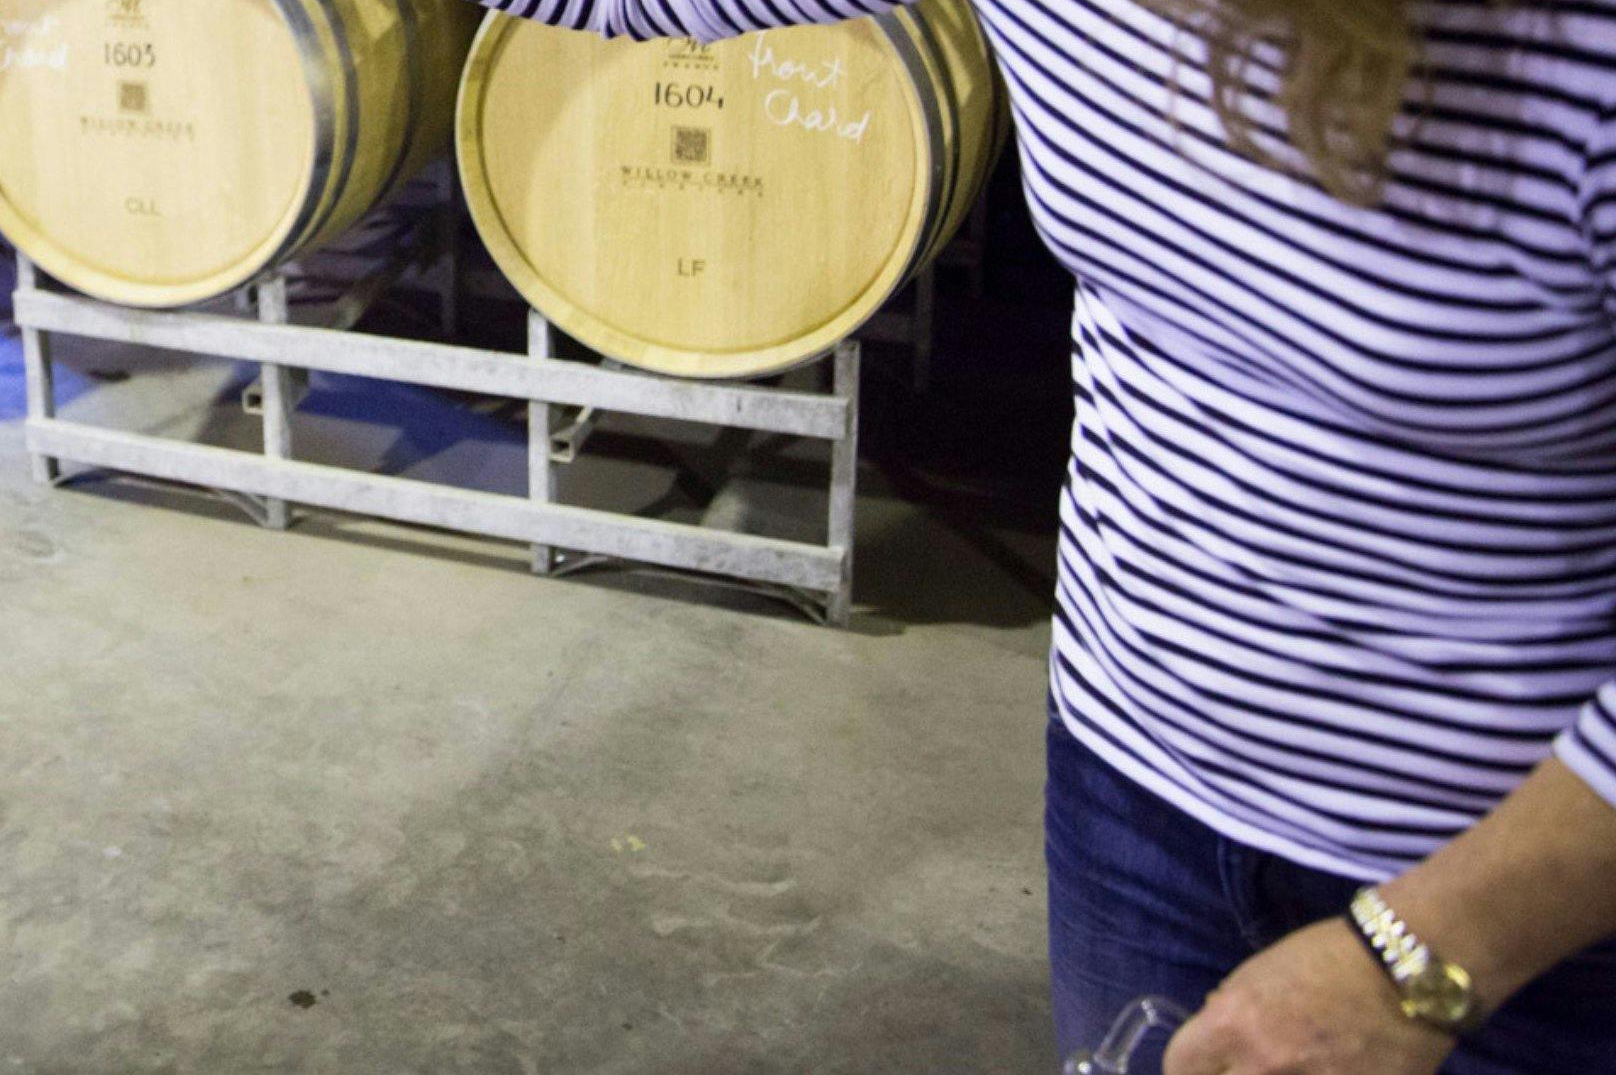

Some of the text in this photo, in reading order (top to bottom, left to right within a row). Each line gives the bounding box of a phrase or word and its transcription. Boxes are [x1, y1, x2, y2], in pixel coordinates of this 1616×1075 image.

[654, 80, 726, 111] 1604
[765, 88, 871, 144] Chard
[676, 257, 707, 277] LF
